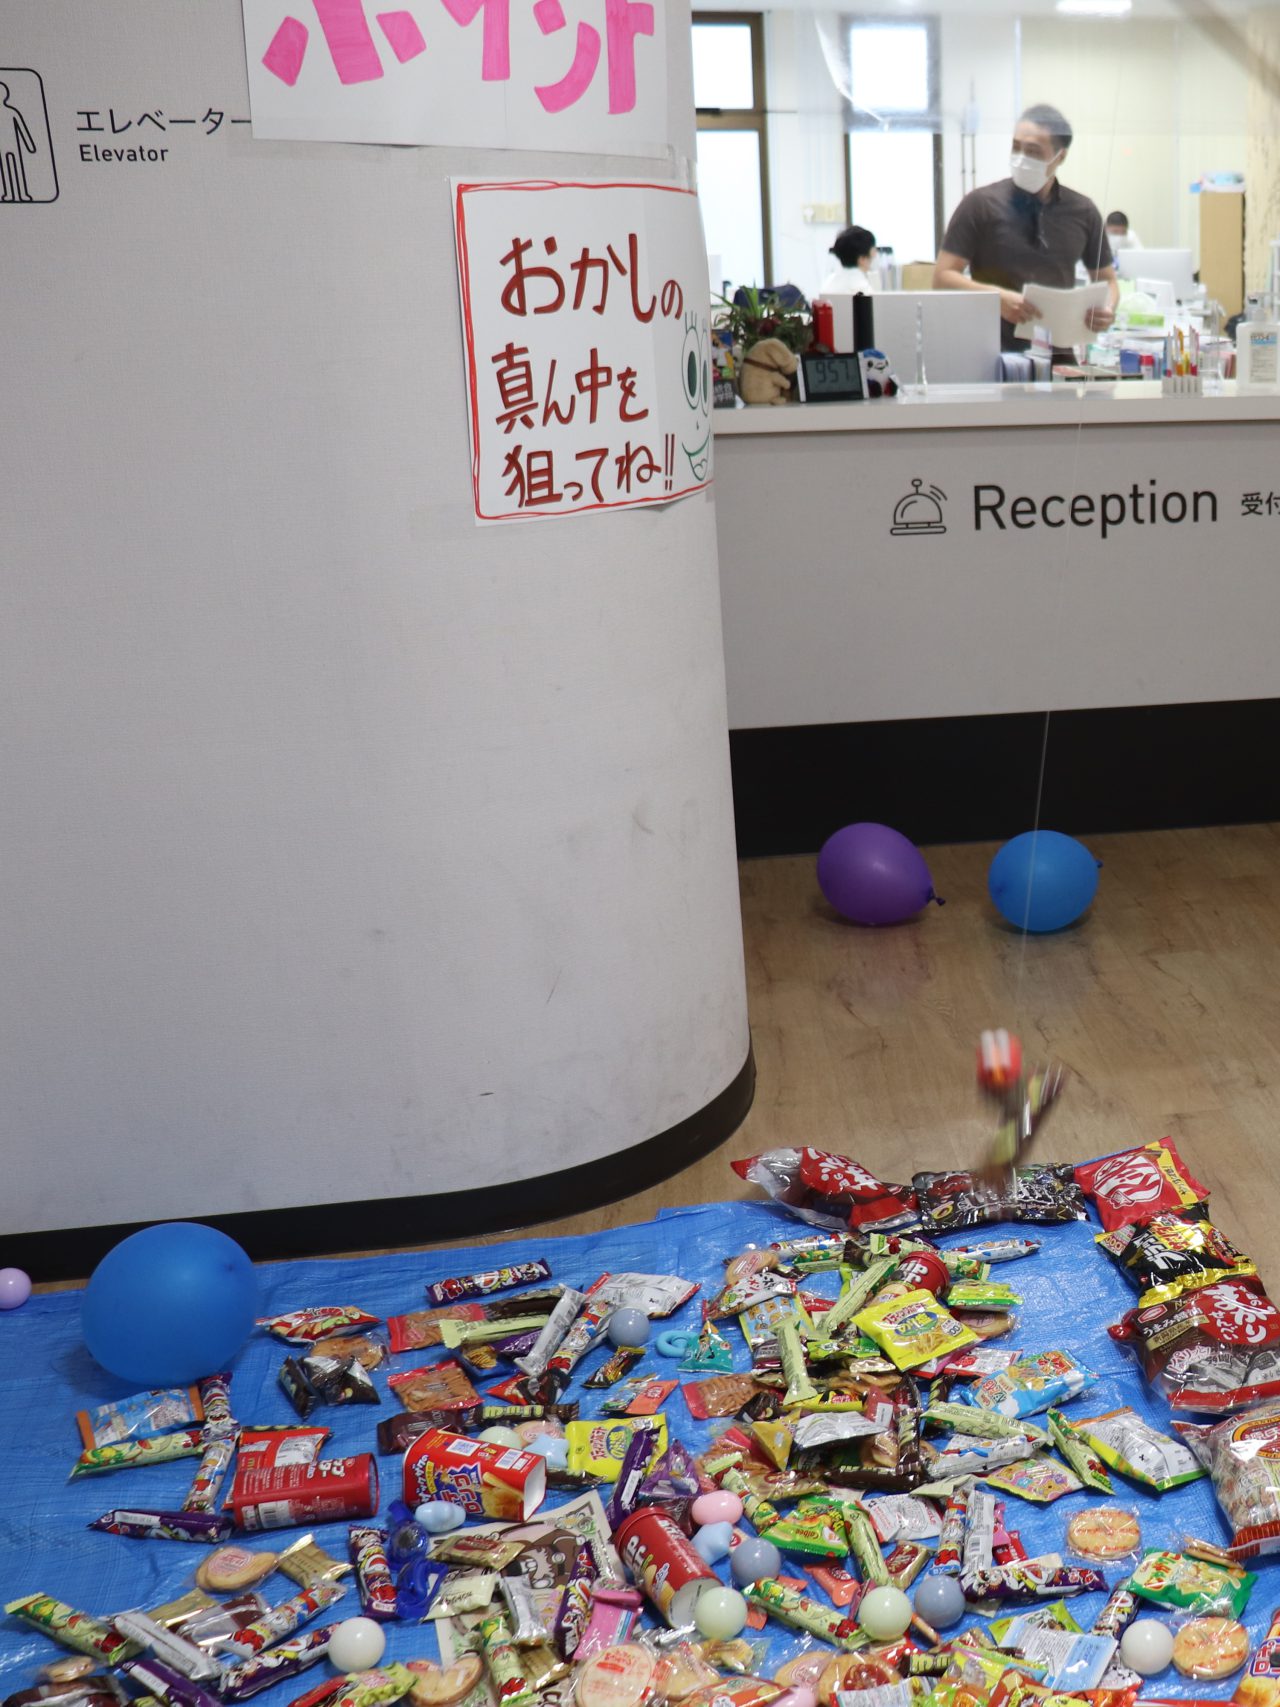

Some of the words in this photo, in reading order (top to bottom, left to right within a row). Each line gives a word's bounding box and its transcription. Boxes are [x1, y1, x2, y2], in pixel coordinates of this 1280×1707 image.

[76, 107, 252, 135] エレベーター
[79, 144, 169, 162] Elevator
[499, 233, 684, 323] おかしの
[491, 342, 649, 434] 真ん中を
[501, 433, 675, 508] 狙ってね!!
[973, 479, 1218, 539] Reception
